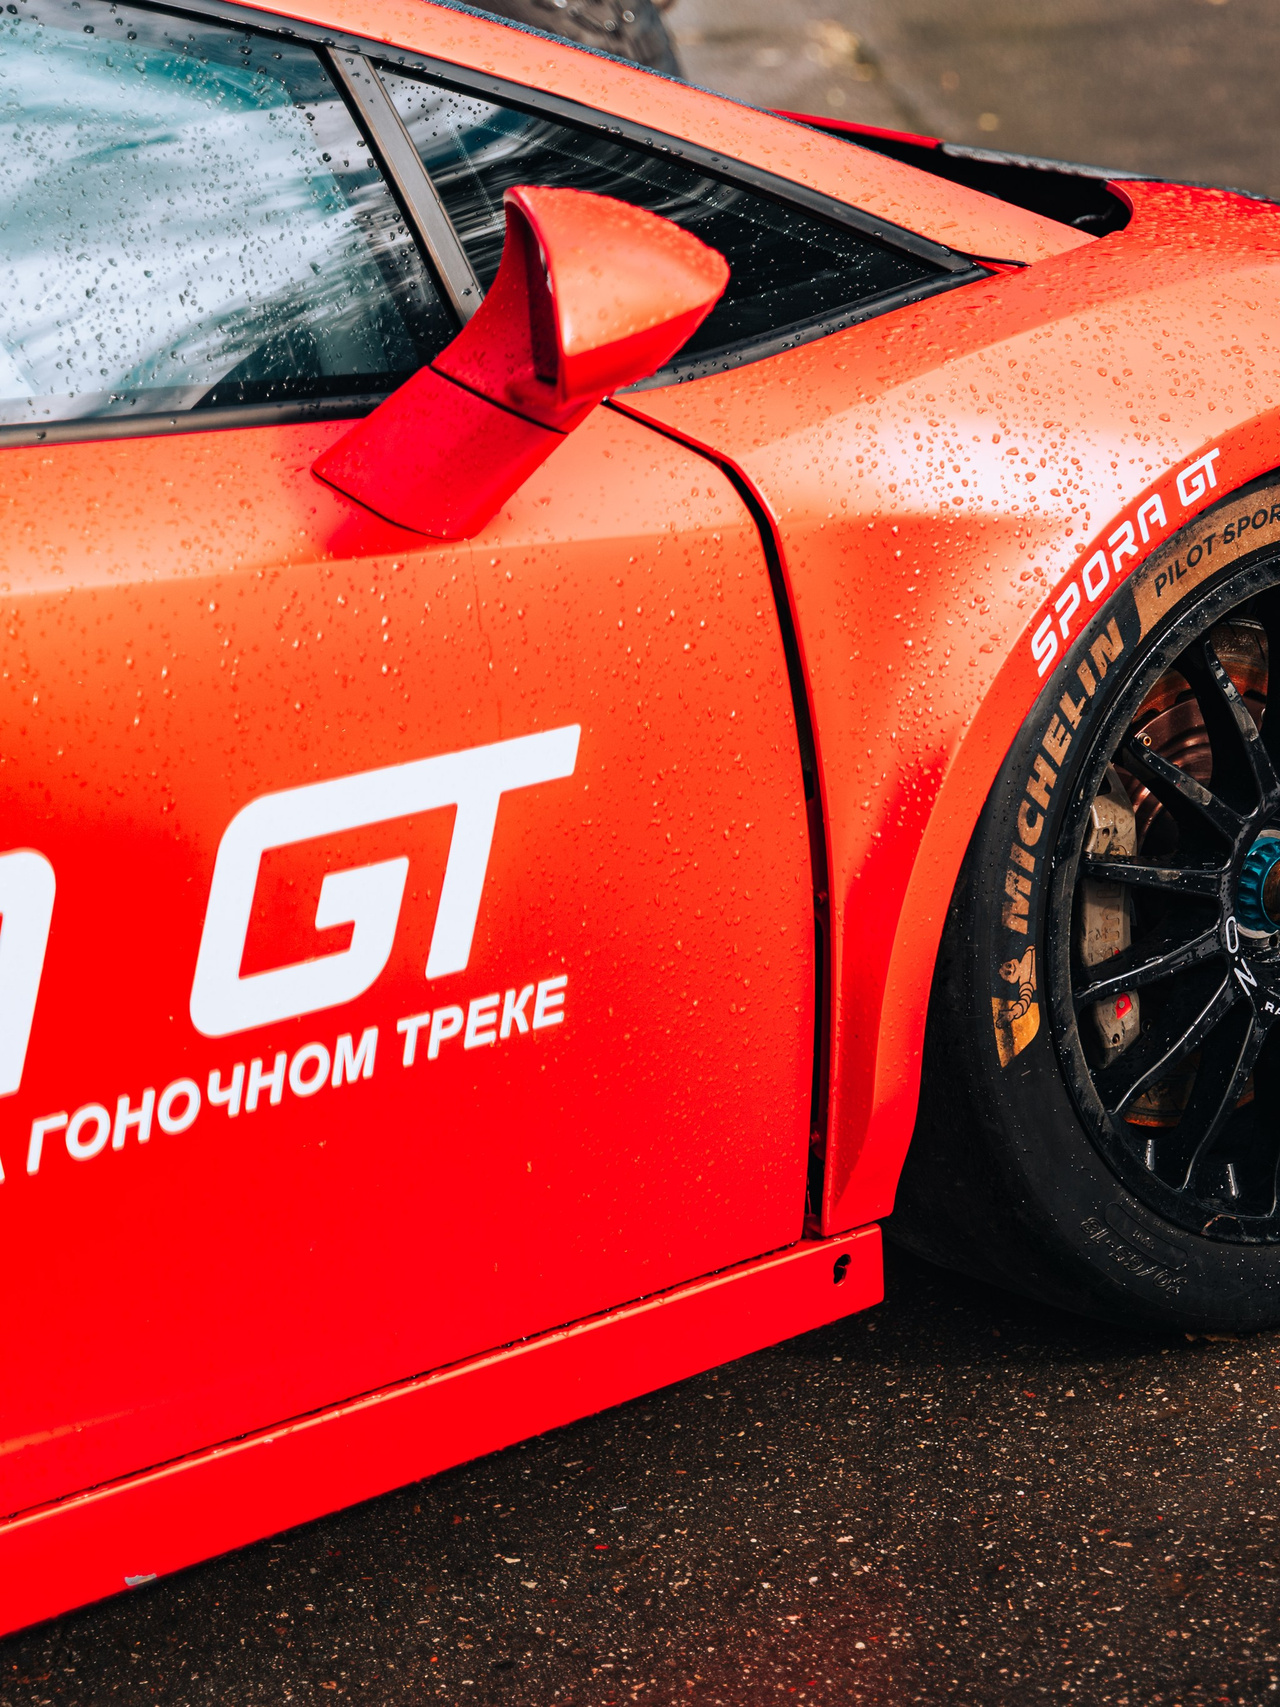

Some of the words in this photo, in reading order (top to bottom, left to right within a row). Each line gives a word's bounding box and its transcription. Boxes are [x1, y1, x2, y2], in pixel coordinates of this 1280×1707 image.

[1031, 493, 1167, 678] SPORA
[1176, 447, 1220, 507] GT
[1154, 532, 1217, 598] PILOT
[190, 723, 581, 1038] GT
[1001, 616, 1125, 935] MICHELIN
[26, 1026, 379, 1175] ГОНОЧНОМ
[396, 975, 568, 1067] ТРЕКЕ
